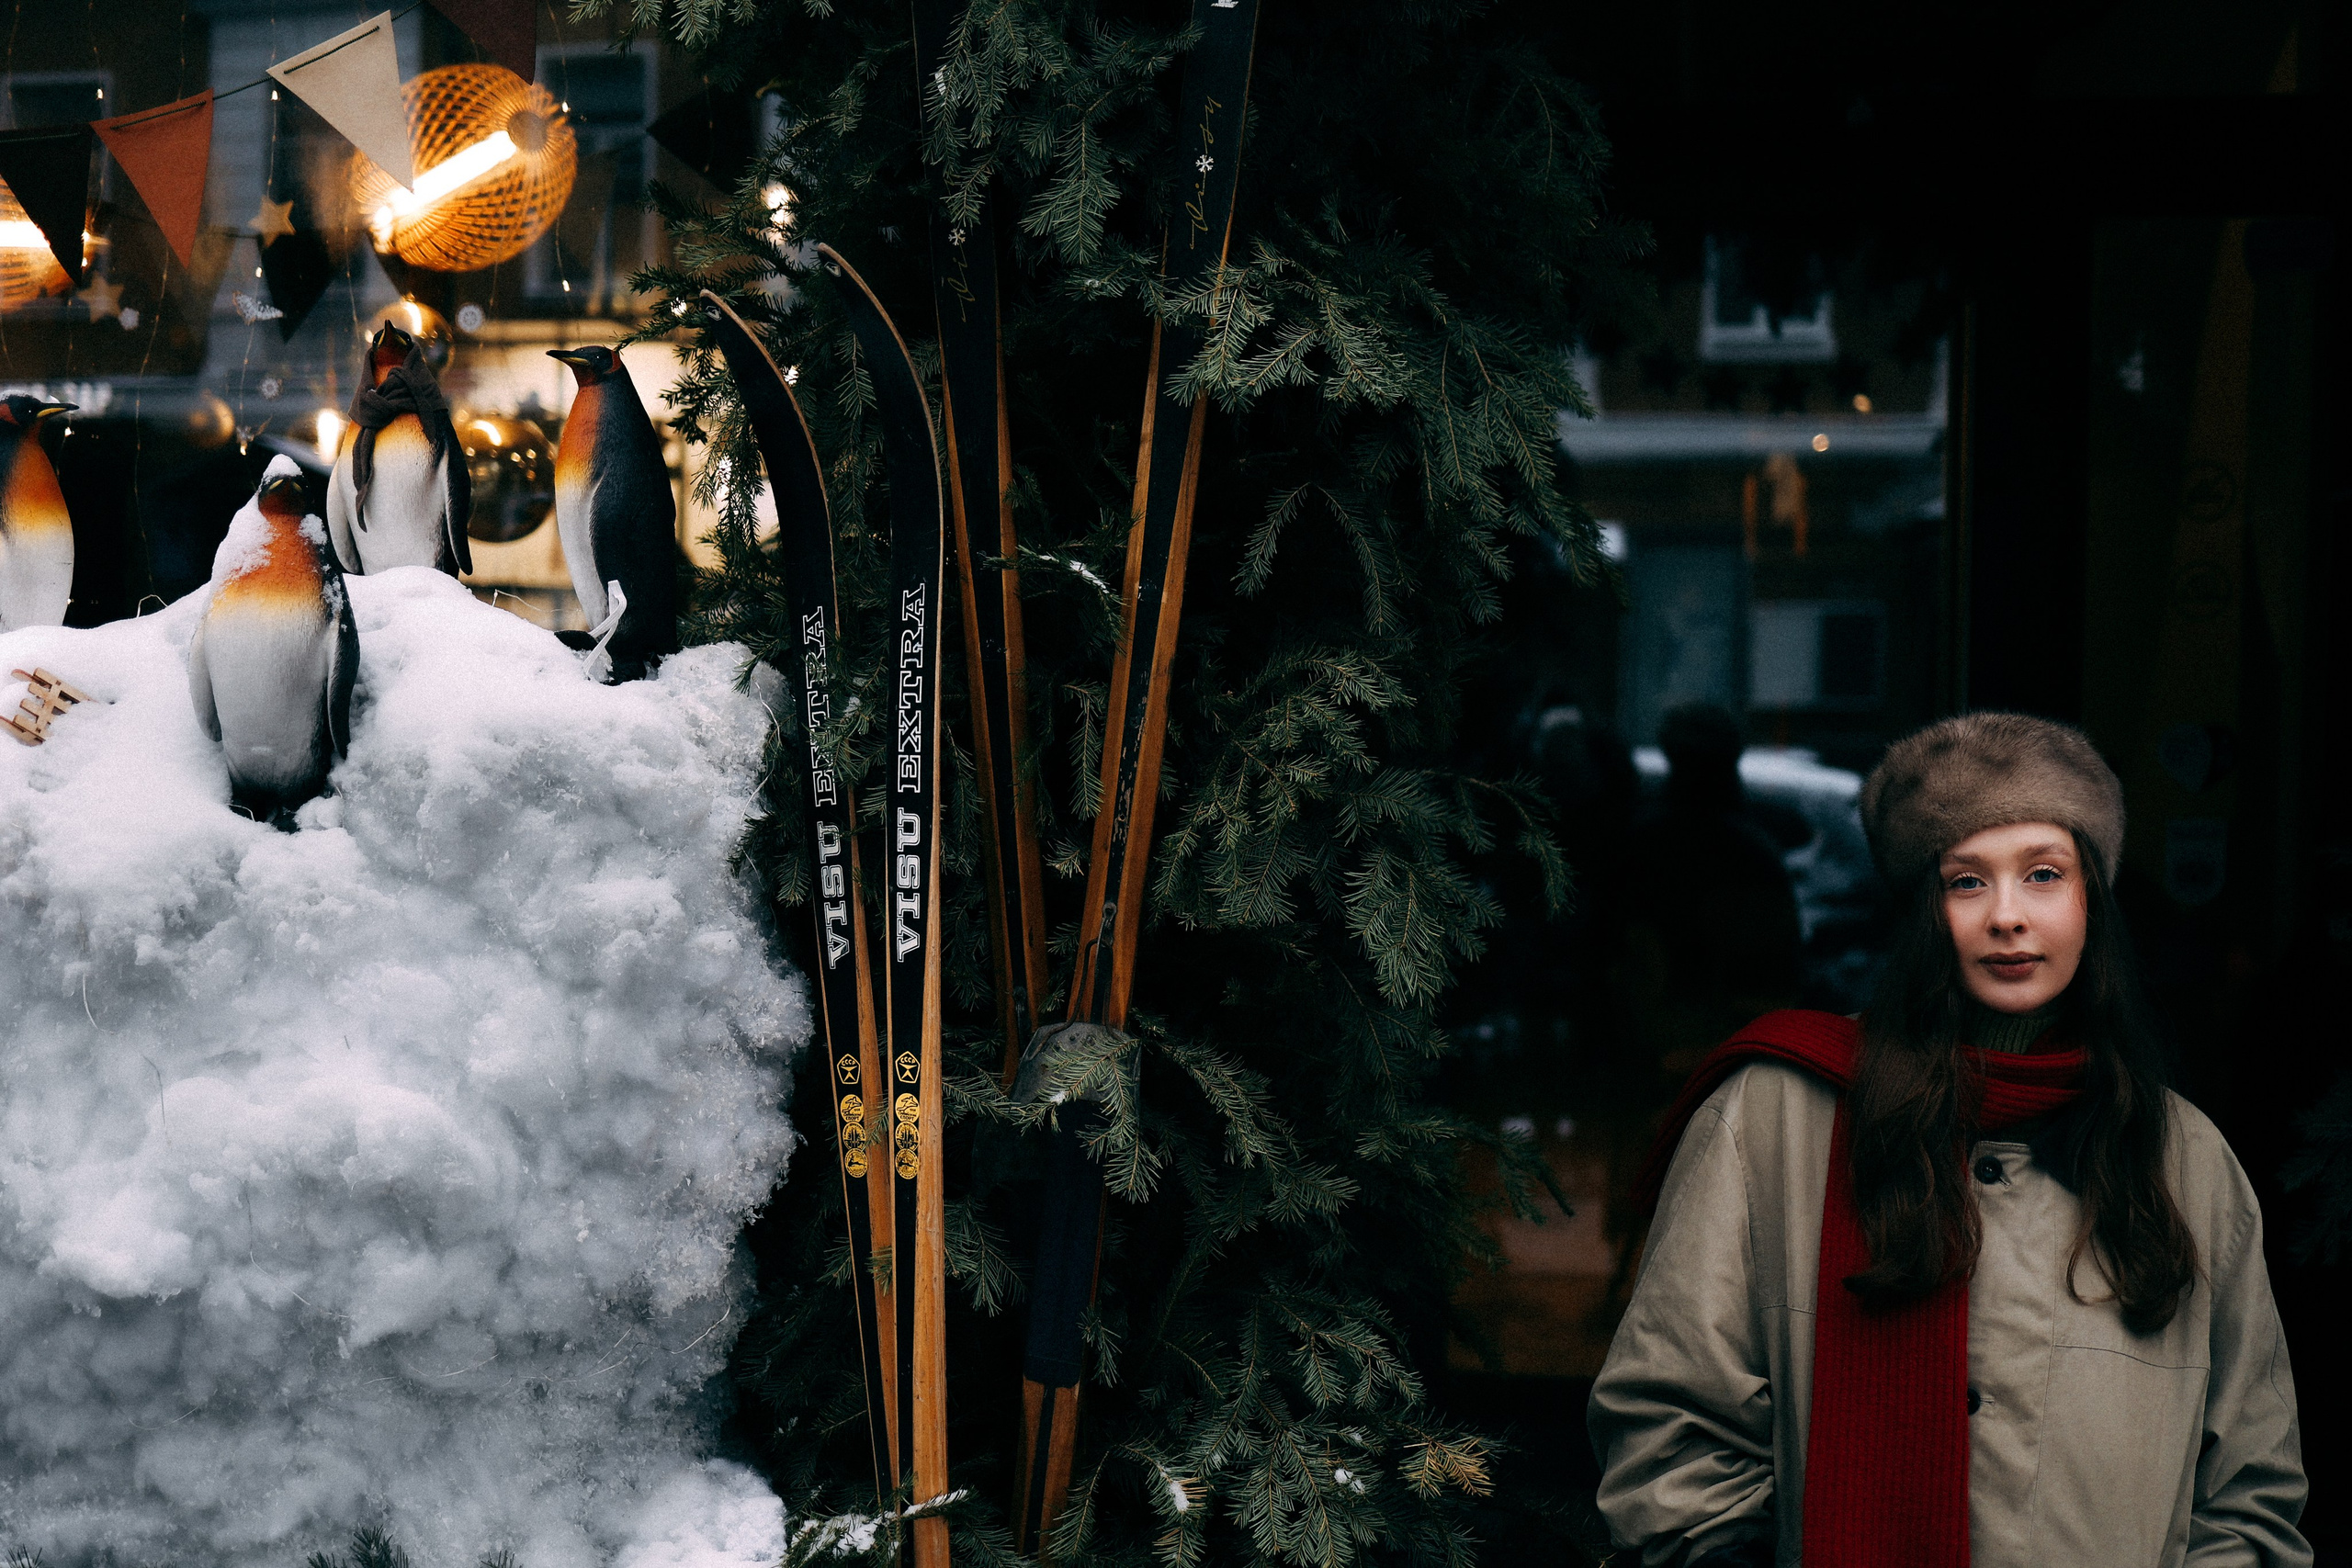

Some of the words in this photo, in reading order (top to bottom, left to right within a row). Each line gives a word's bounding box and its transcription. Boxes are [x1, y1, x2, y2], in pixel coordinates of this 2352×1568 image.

[897, 582, 925, 794] EXTRA
[816, 820, 851, 970] VISU
[897, 807, 921, 963] VISU
[841, 1058, 856, 1066] СССР
